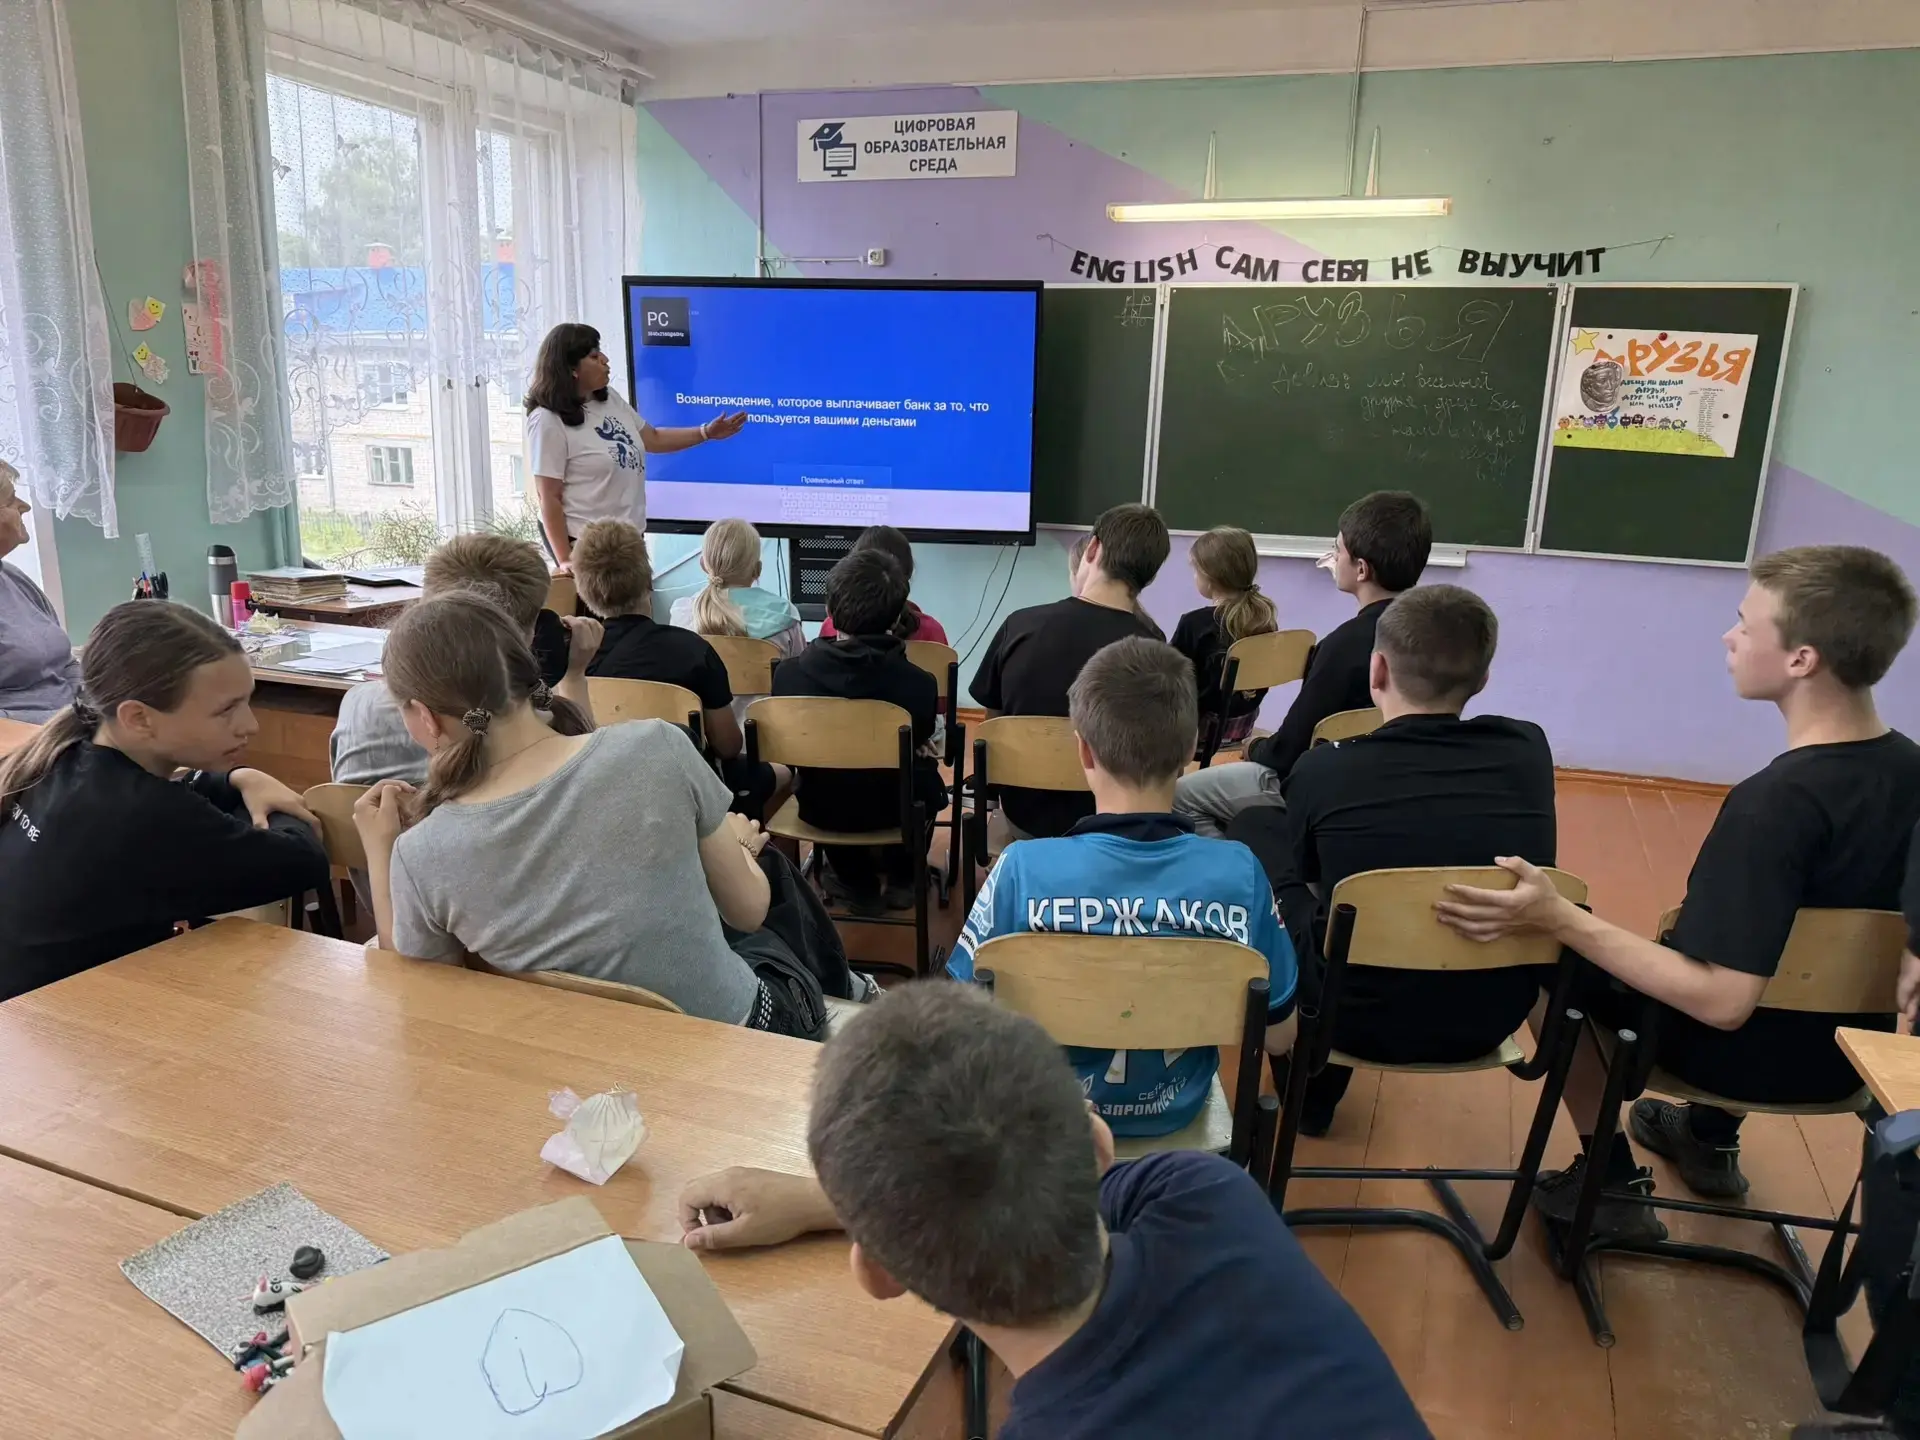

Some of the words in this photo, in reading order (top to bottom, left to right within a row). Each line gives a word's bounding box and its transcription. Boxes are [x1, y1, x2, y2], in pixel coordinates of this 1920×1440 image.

[894, 117, 976, 136] ЦИФРОВАЯ
[864, 136, 1007, 154] ОБРАЗОВАТЕЛЬНАЯ
[909, 158, 958, 173] СРЕДА
[1070, 248, 1199, 284] ENGLISH
[1215, 245, 1280, 283] САМ
[1301, 258, 1369, 283] СЕБЯ
[1391, 249, 1433, 281] НЕ
[1457, 247, 1606, 279] ВЫУЧИТ
[647, 311, 669, 327] PC
[676, 392, 774, 408] Вознаграждение,
[777, 397, 823, 409] которое
[826, 399, 901, 410] выплачивает
[904, 398, 931, 411] банк
[933, 402, 947, 411] за
[951, 402, 966, 412] то,
[969, 402, 990, 412] что
[747, 413, 811, 426] пользуется
[814, 416, 859, 426] вашими
[861, 416, 917, 428] деньгами
[801, 476, 844, 485] Правильный
[20, 814, 30, 829] TO
[27, 825, 40, 842] BE
[1027, 897, 1250, 946] КЕРЖАКОВ
[1092, 1076, 1188, 1117] АЗПРОМНЕФТЬ
